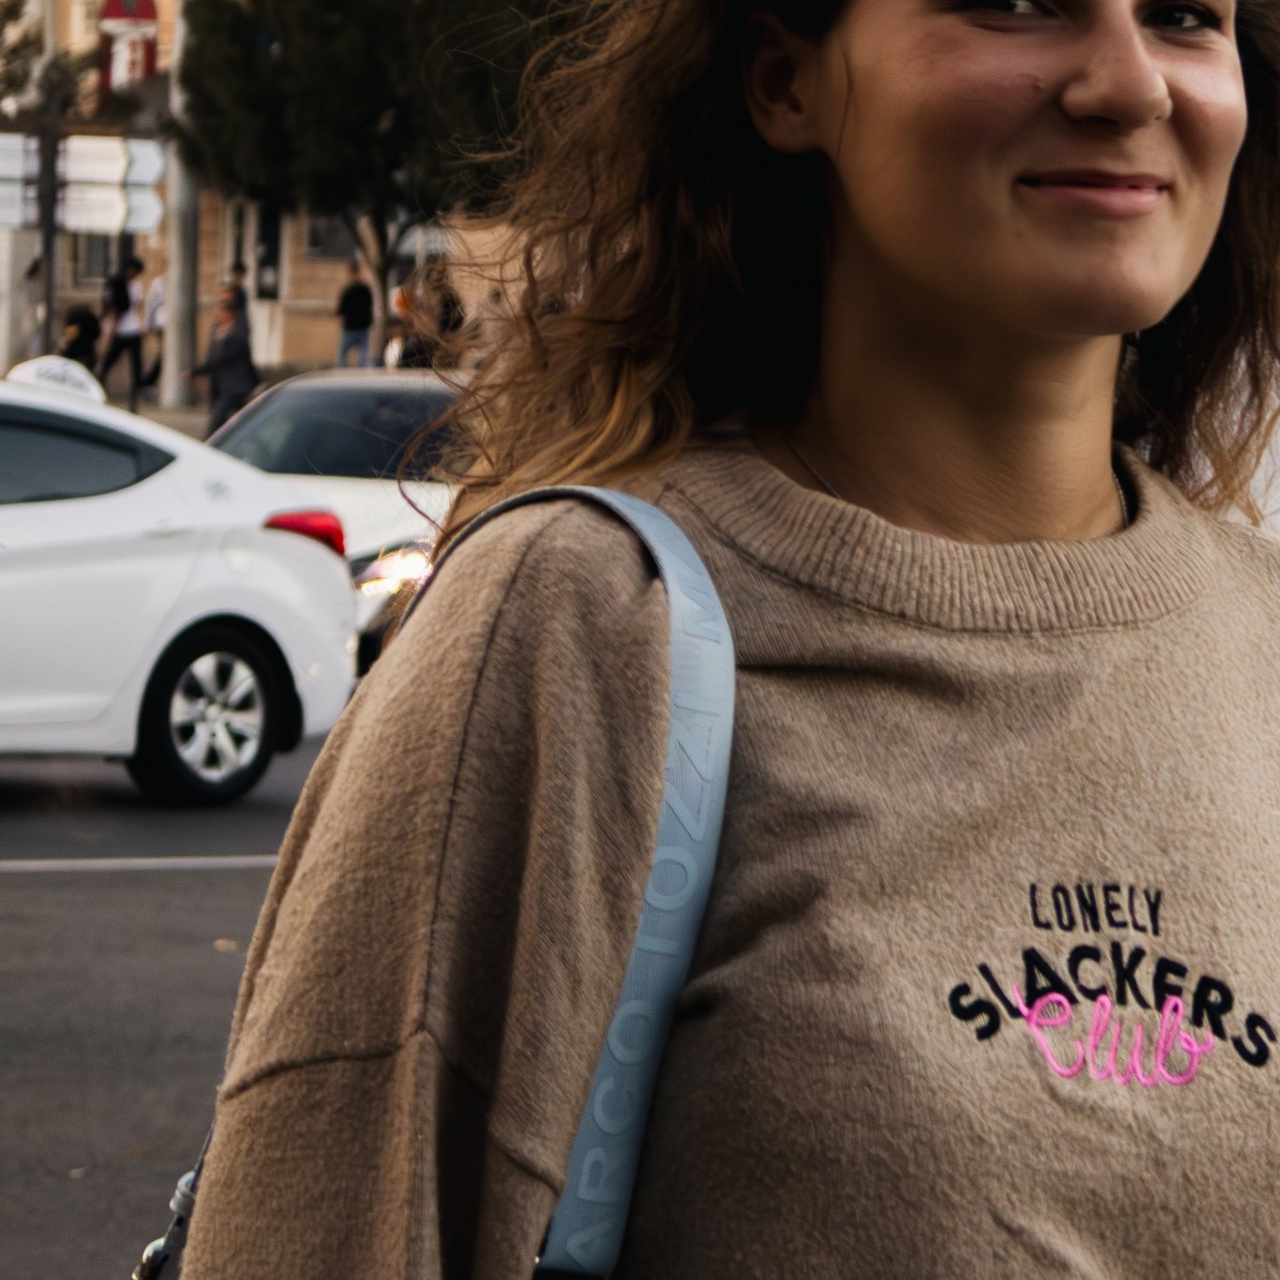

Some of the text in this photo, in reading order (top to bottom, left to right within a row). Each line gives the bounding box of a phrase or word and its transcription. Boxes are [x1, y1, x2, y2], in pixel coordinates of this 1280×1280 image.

[1029, 882, 1163, 937] LONELY
[948, 940, 1277, 1069] SLACKERS
[566, 999, 658, 1272] ARCO
